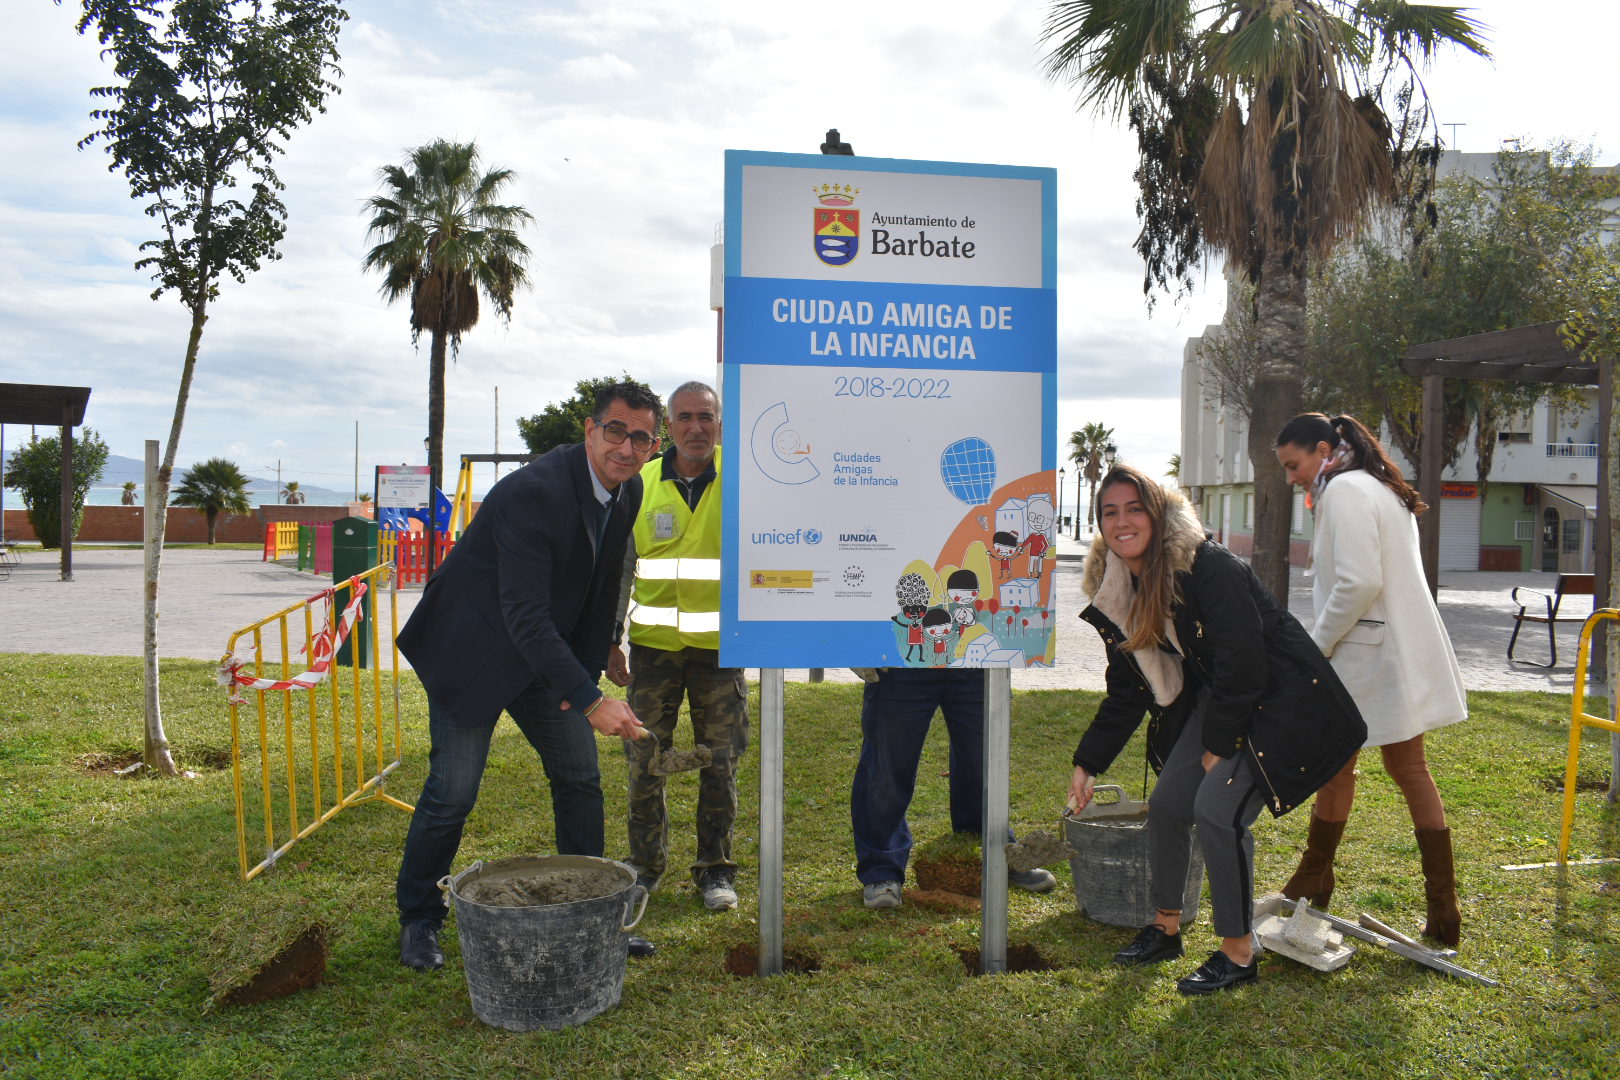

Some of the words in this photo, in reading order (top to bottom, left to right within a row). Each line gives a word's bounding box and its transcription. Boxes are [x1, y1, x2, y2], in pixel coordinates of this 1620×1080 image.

[871, 211, 957, 228] Ayuntamiento
[961, 216, 976, 229] de
[871, 229, 976, 259] Barbate
[772, 297, 874, 326] CIUDAD
[881, 302, 972, 329] AMIGA
[980, 305, 1013, 331] DE
[810, 330, 843, 357] LA
[850, 332, 977, 360] INFANCIA
[834, 376, 952, 400] 2018-2022
[833, 452, 881, 463] Ciudades
[833, 463, 873, 477] Amigas
[833, 475, 846, 486] de
[848, 475, 857, 486] la
[860, 475, 898, 487] Infancia
[751, 528, 802, 544] unicef
[839, 533, 878, 543] IUNDIA
